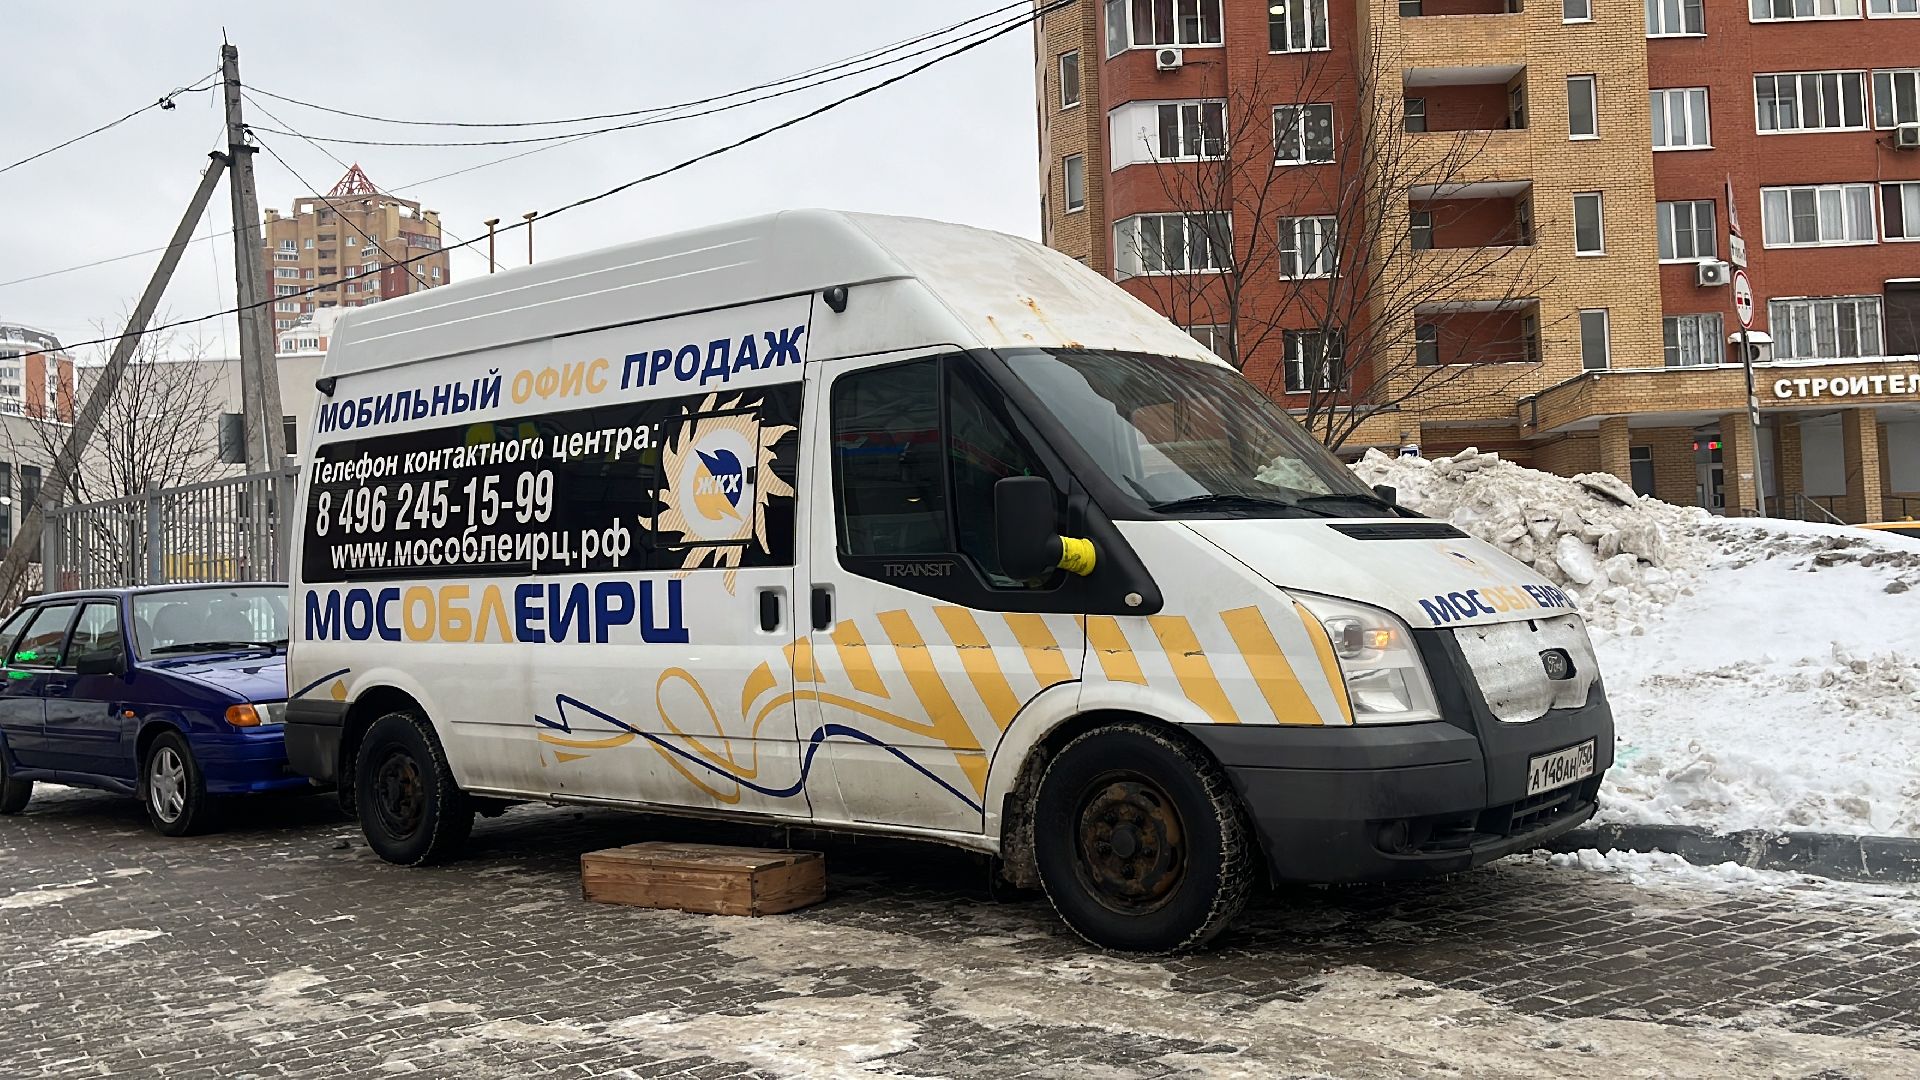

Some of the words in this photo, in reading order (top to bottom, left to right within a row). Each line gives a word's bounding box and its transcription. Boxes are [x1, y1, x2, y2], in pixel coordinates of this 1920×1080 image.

[318, 368, 502, 434] МОБИЛЬНЫЙ
[511, 358, 609, 405] ОФИС
[620, 325, 805, 390] ПРОДАЖ
[1774, 374, 1920, 398] СТРОИТЕЛ
[313, 452, 398, 486] Телефон
[404, 437, 544, 475] контактного
[552, 423, 659, 463] центра:
[316, 491, 330, 537] 8
[338, 485, 387, 534] 496
[395, 469, 554, 531] 245-15-99
[696, 473, 741, 496] ЖКХ
[331, 517, 631, 571] www.мособлеирц.рф
[883, 563, 954, 577] TRANSIT
[305, 579, 690, 644] МОСОБЛЕИРЦ
[1547, 655, 1563, 673] Ford
[1579, 743, 1592, 766] 750
